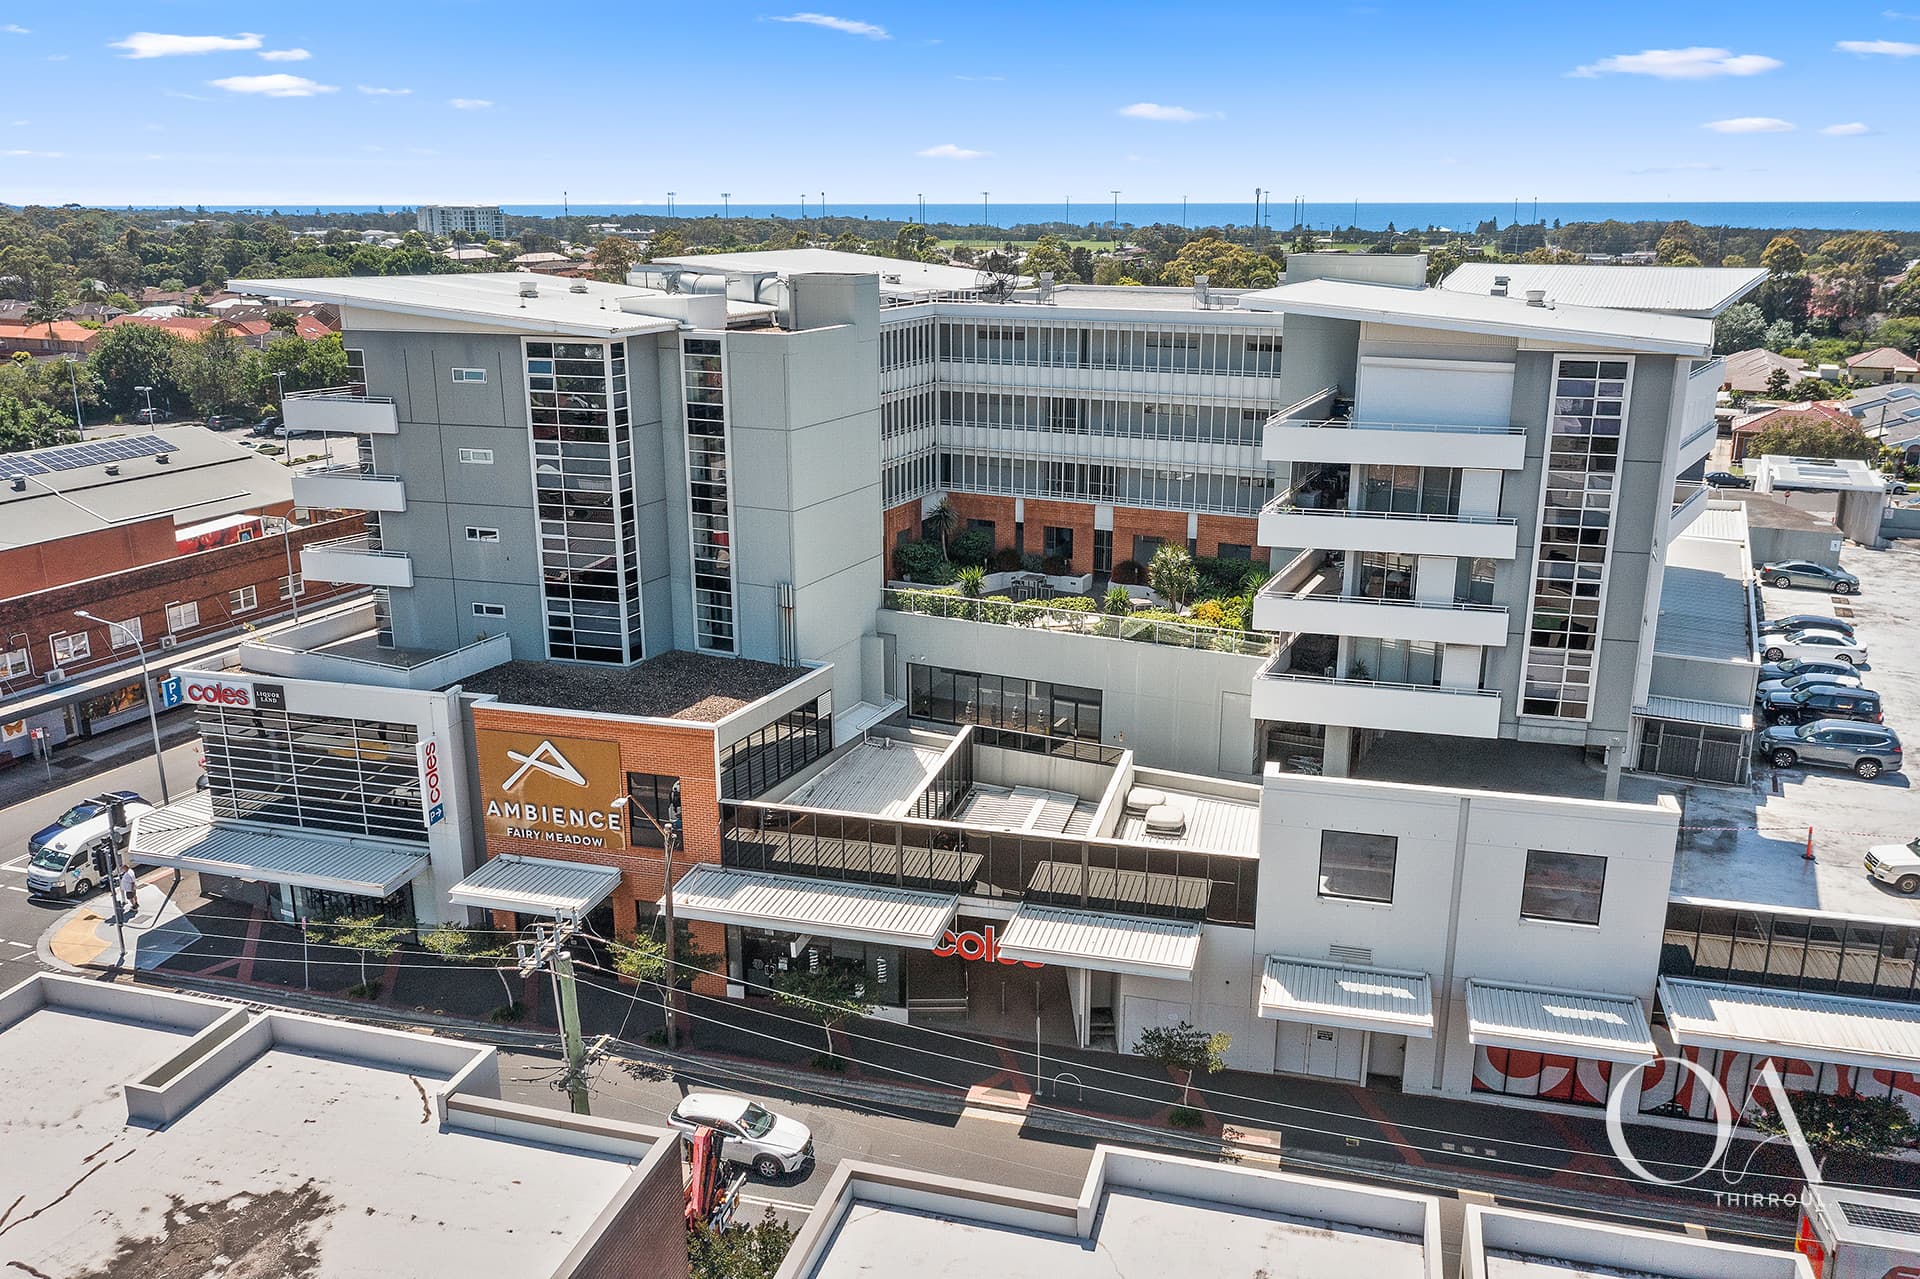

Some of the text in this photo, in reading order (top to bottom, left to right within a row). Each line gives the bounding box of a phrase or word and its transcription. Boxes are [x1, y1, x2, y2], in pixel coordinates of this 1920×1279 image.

[168, 682, 177, 695] P
[187, 682, 250, 706] coles
[255, 690, 281, 699] LIQUOR
[425, 741, 441, 804] coles
[487, 800, 622, 831] AMBIENCE
[506, 827, 604, 847] FAIRY MEADOW
[931, 925, 1046, 969] col
